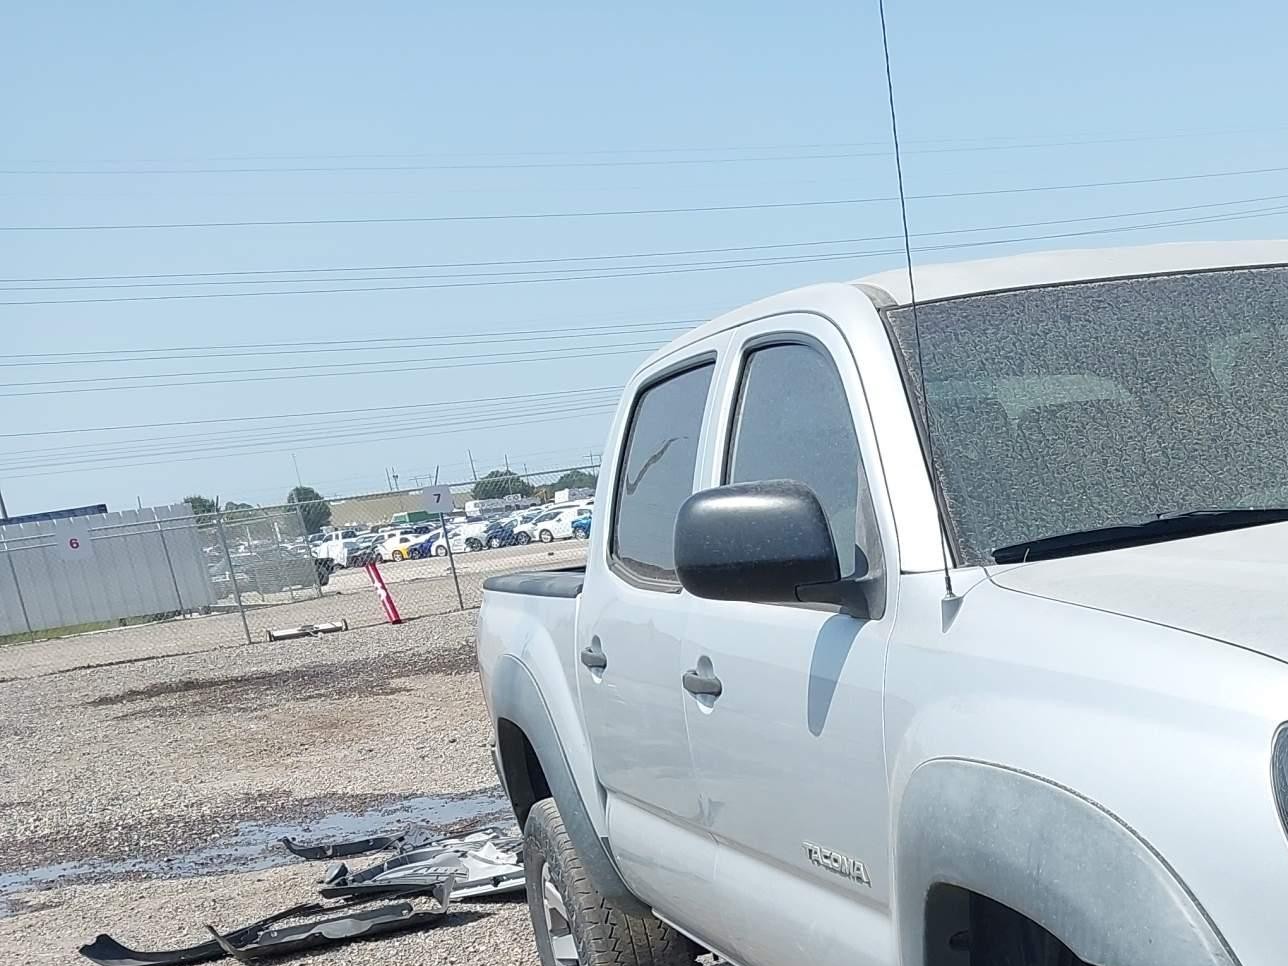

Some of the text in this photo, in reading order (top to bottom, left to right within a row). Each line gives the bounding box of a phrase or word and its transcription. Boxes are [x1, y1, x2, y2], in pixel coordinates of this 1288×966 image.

[432, 493, 441, 503] 7
[69, 538, 80, 549] 6
[801, 840, 872, 888] TACOMA
